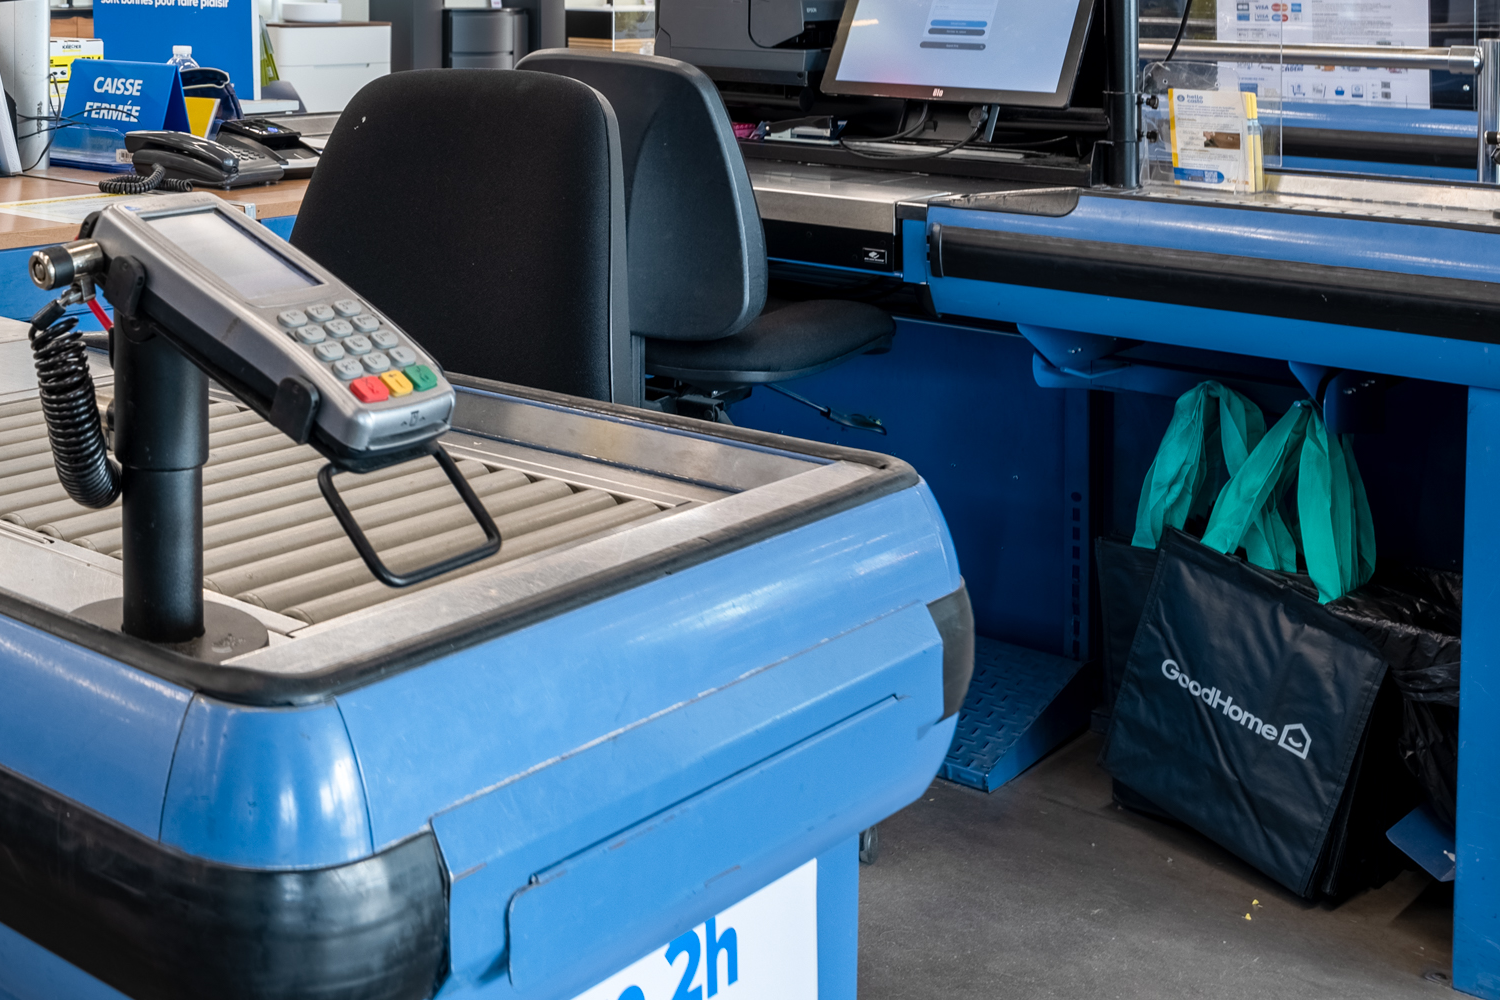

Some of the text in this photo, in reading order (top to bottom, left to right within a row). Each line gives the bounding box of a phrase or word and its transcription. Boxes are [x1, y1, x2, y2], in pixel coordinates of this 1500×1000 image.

[93, 76, 143, 97] CAISSE
[83, 100, 141, 123] FERMÉE
[1161, 658, 1278, 741] GoodHome
